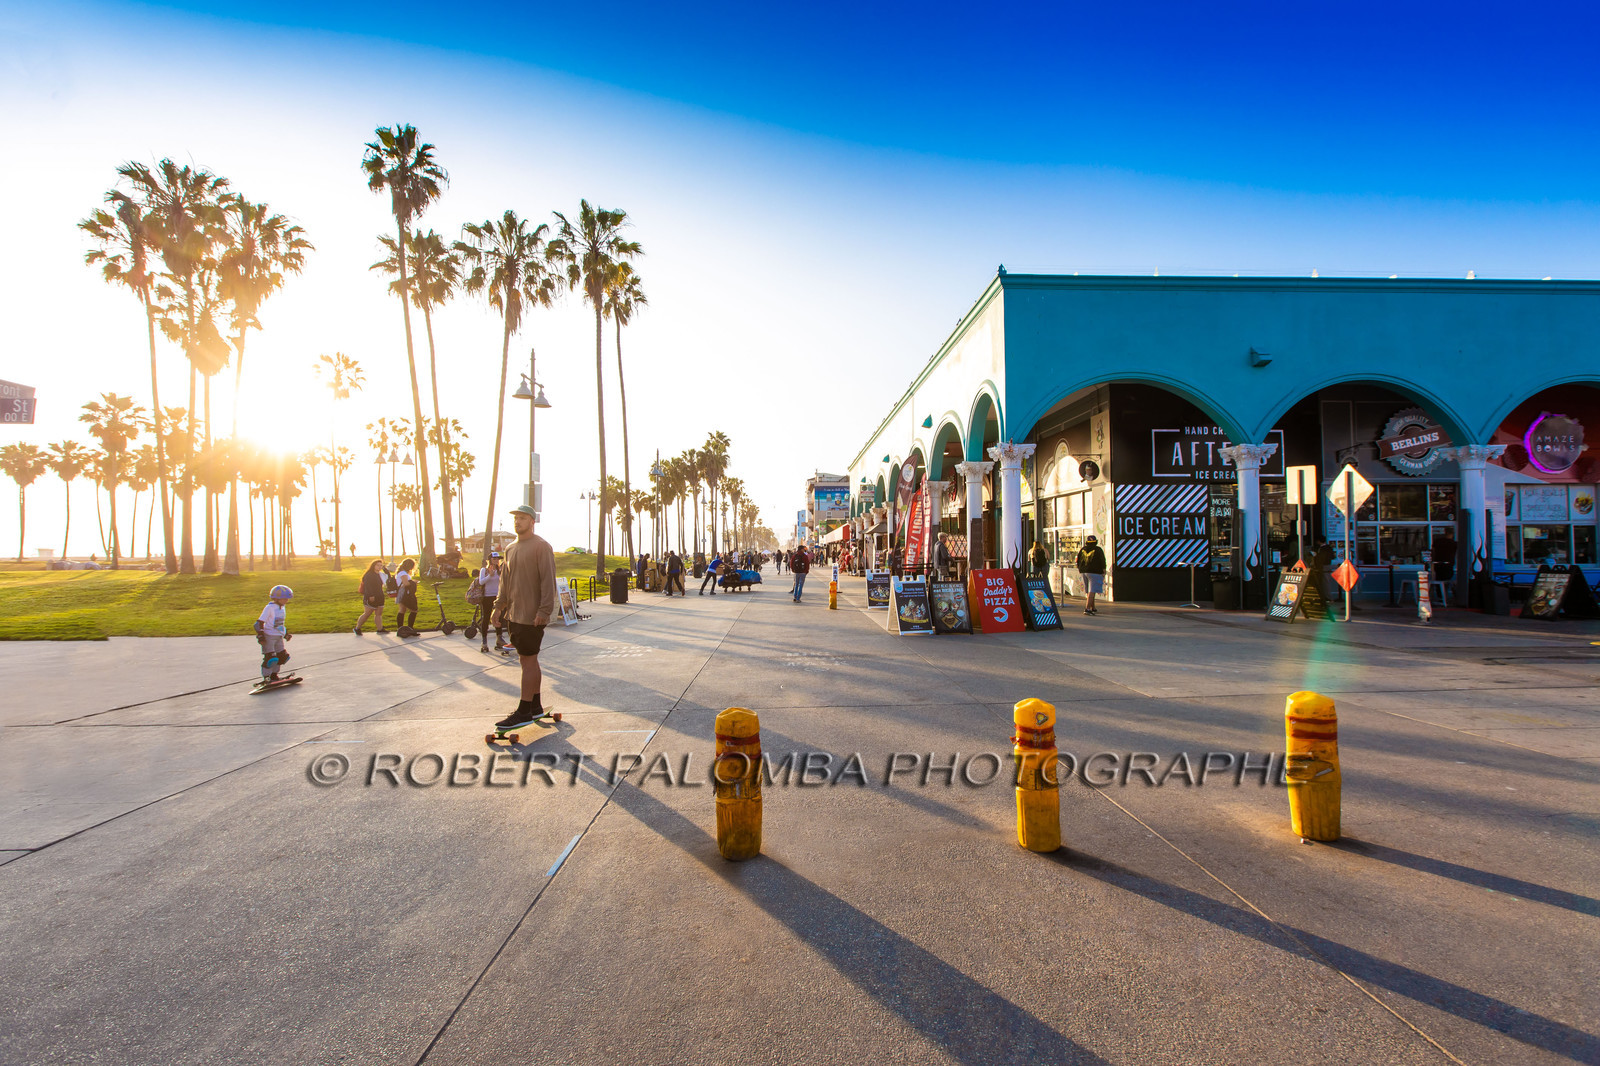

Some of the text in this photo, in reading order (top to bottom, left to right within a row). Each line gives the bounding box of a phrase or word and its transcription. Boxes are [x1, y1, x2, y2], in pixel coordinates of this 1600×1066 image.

[13, 399, 28, 413] St
[1184, 426, 1227, 435] HAND CR
[1391, 432, 1440, 451] BERLINS
[1536, 435, 1574, 443] AMAZE
[1536, 444, 1575, 452] BOWLS
[1172, 441, 1268, 466] AFTE
[1399, 457, 1424, 469] GERMAN
[1195, 470, 1238, 480] ICE CREA
[1211, 498, 1231, 506] MORE
[1119, 516, 1206, 536] ICE CREAM
[906, 543, 918, 568] VAPE
[986, 577, 1005, 586] BIG
[983, 586, 1013, 597] Daddy's
[984, 597, 1015, 606] PIZZA
